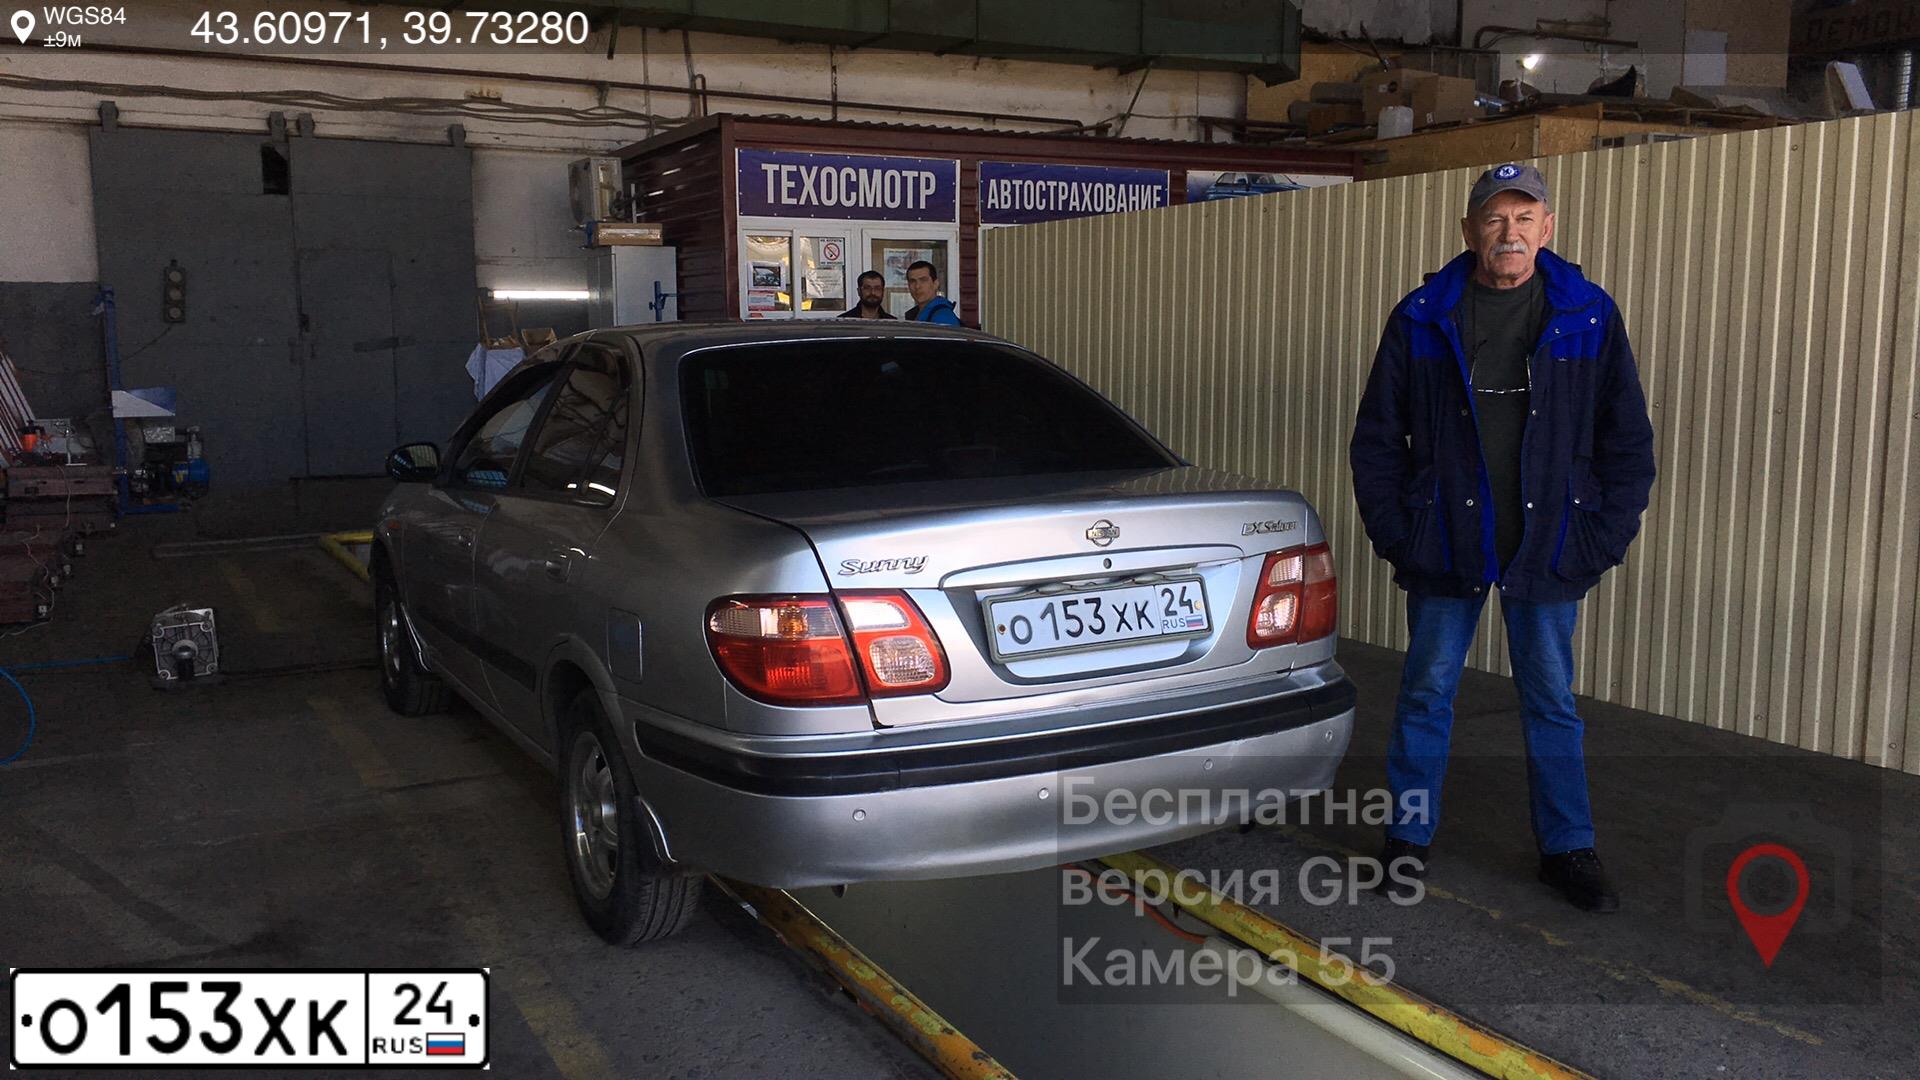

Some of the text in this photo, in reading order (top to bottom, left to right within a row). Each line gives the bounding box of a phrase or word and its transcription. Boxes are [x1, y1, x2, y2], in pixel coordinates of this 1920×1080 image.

[761, 163, 936, 209] ТЕХОСМОТР
[987, 178, 1162, 213] АВТОСТРАХОВАНИЕ
[838, 555, 930, 576] Sunny
[1161, 586, 1194, 617] 24
[1162, 616, 1186, 629] RUS
